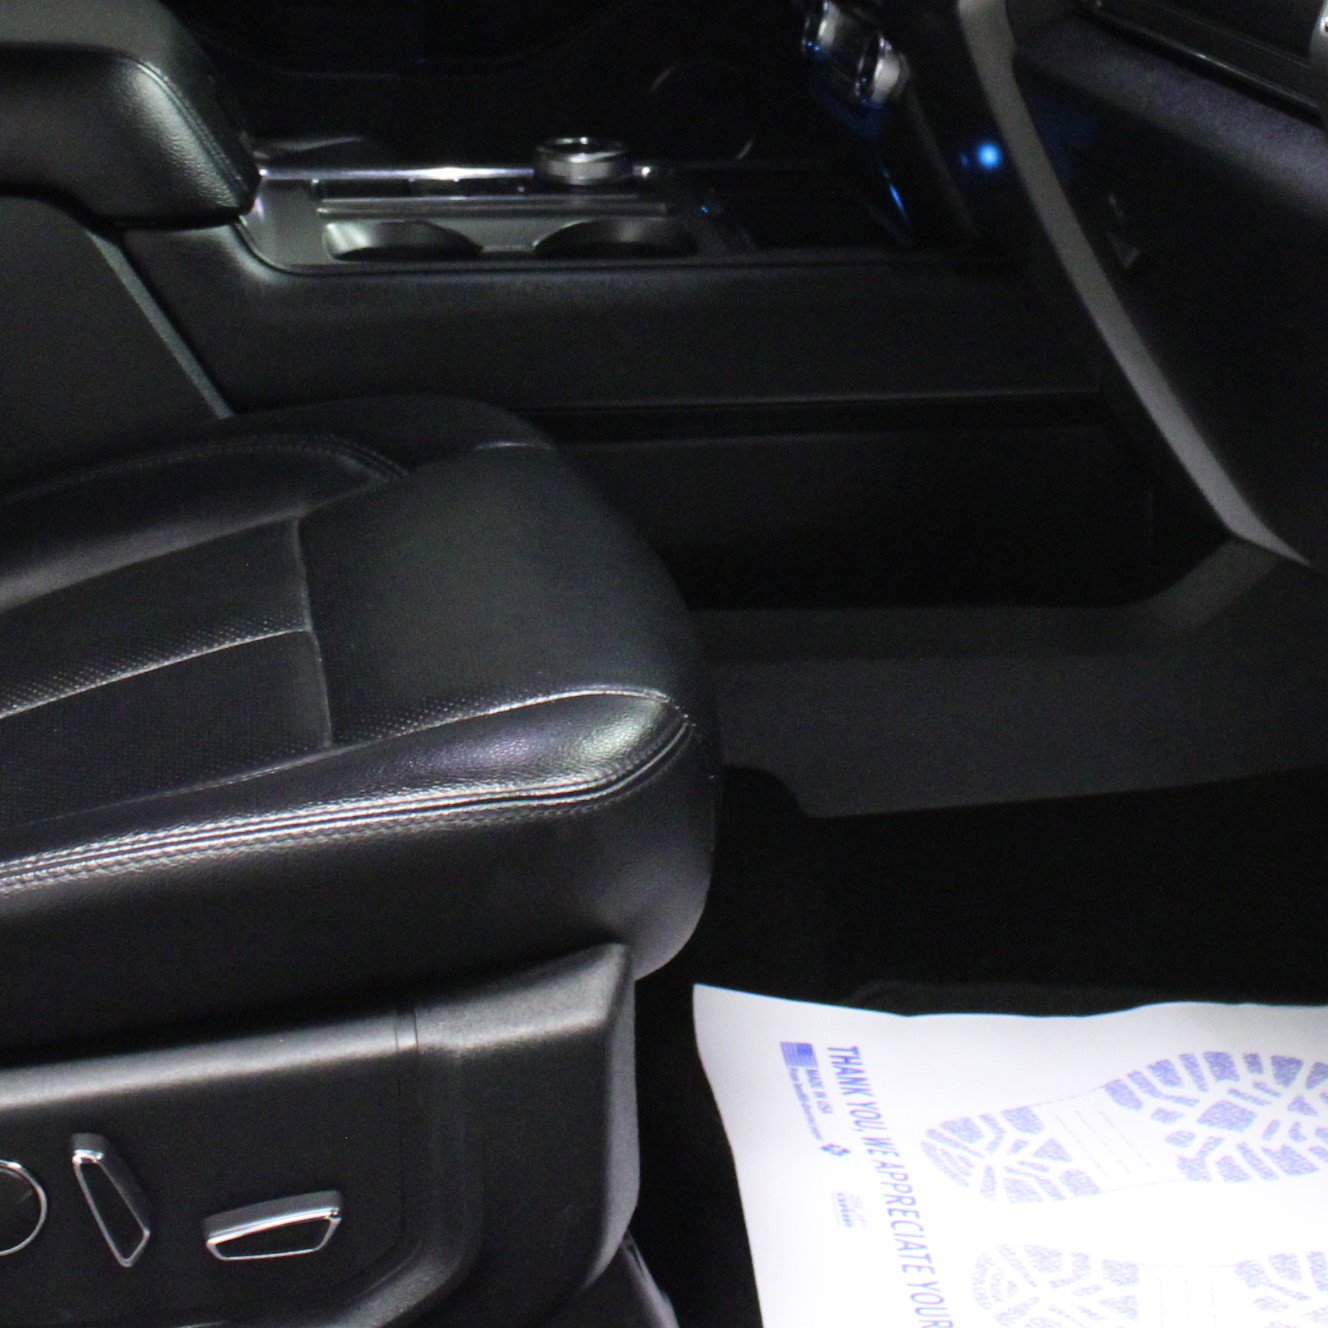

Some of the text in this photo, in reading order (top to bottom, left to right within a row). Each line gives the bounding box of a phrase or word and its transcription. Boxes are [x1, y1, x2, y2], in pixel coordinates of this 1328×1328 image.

[827, 1045, 954, 1328] THANK YOU, WE APPRECIATE YOUR
